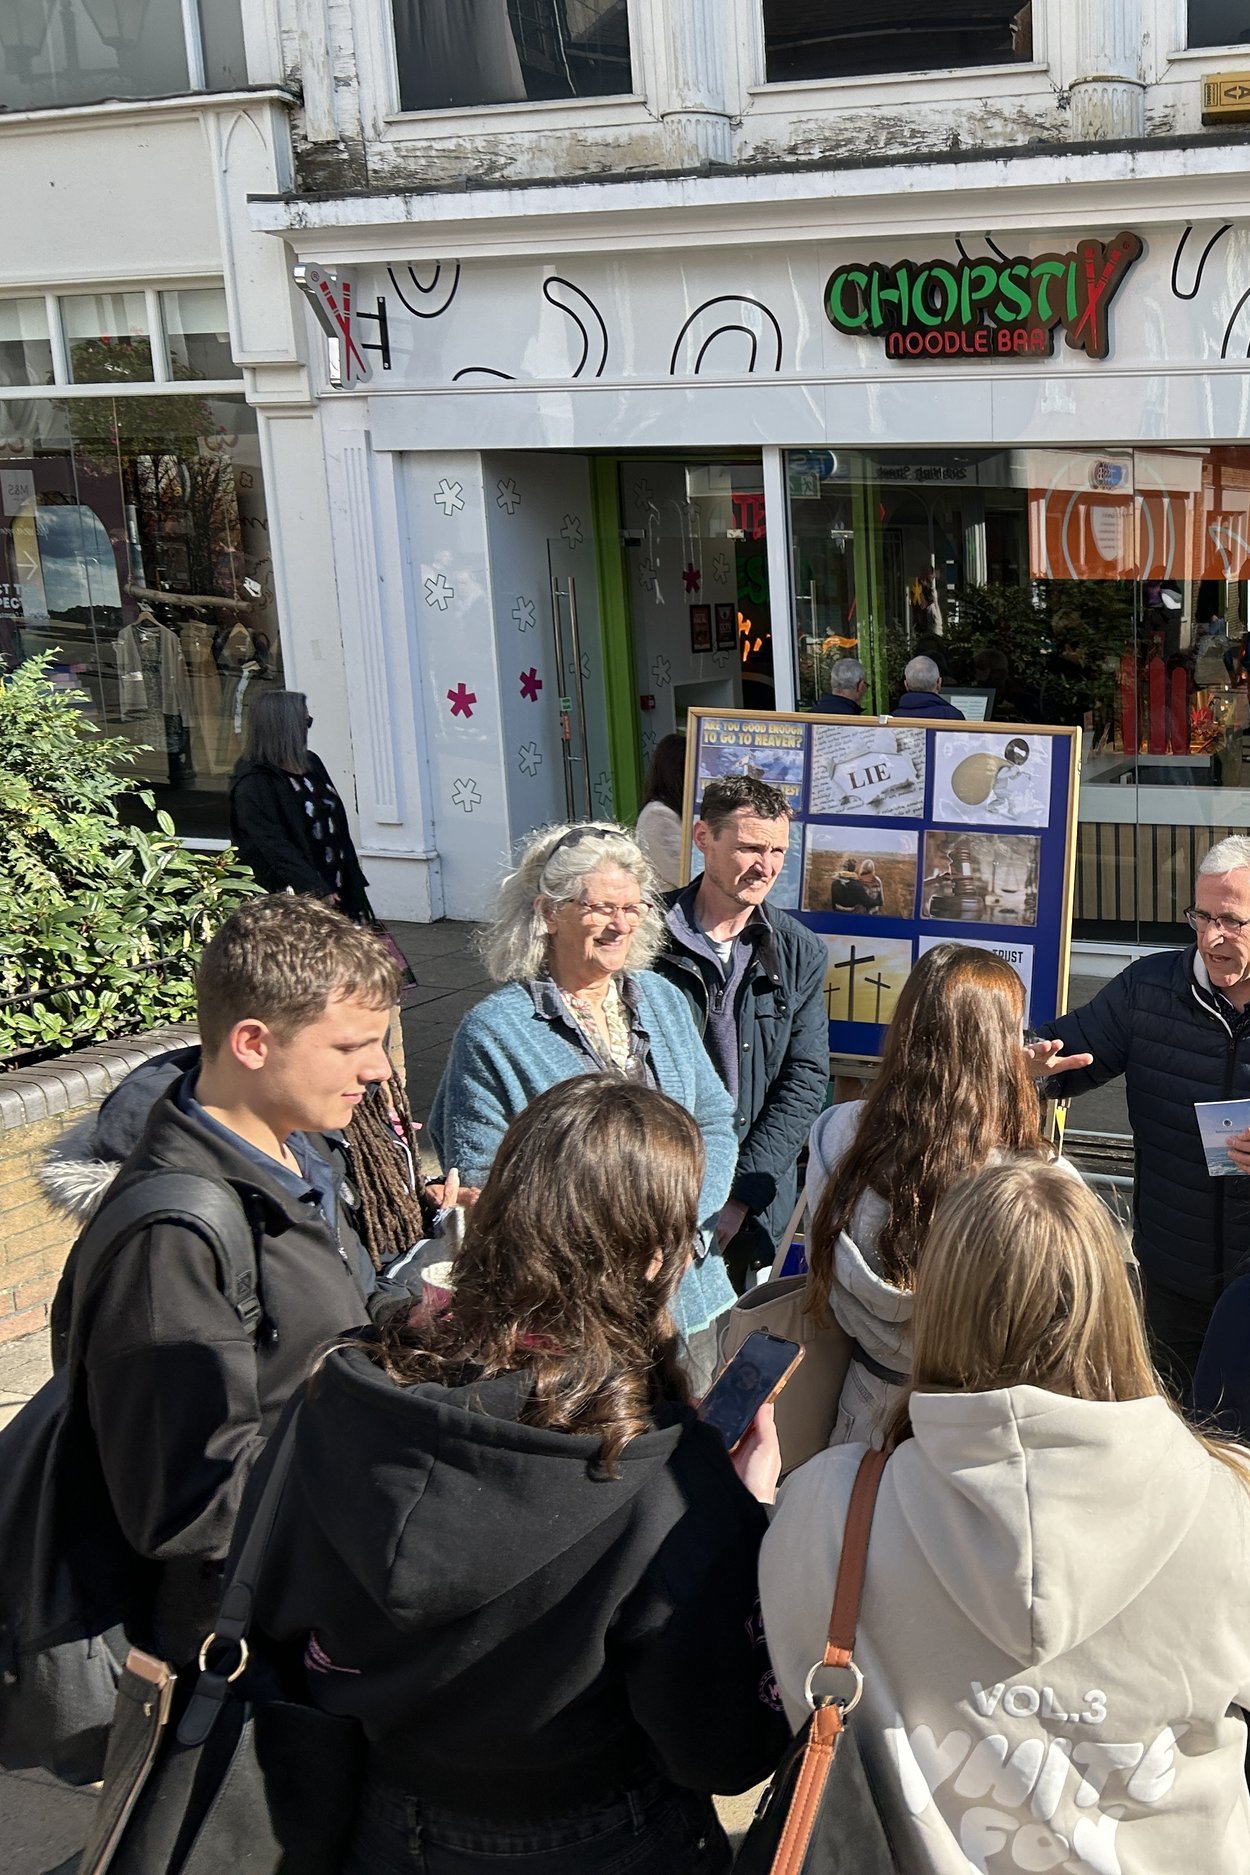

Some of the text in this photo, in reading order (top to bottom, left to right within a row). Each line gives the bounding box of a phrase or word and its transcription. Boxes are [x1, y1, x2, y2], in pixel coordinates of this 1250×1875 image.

[830, 248, 1122, 350] CHOPSTIX
[889, 328, 1046, 354] NOODLE BAR
[703, 721, 803, 735] ARE YOU GOOD ENOUGH
[703, 731, 717, 743] TO
[720, 732, 735, 744] GO
[738, 733, 752, 745] TO
[754, 734, 802, 748] HEAVEN?
[848, 762, 892, 790] LIE
[970, 1681, 1107, 1724] VOL.3
